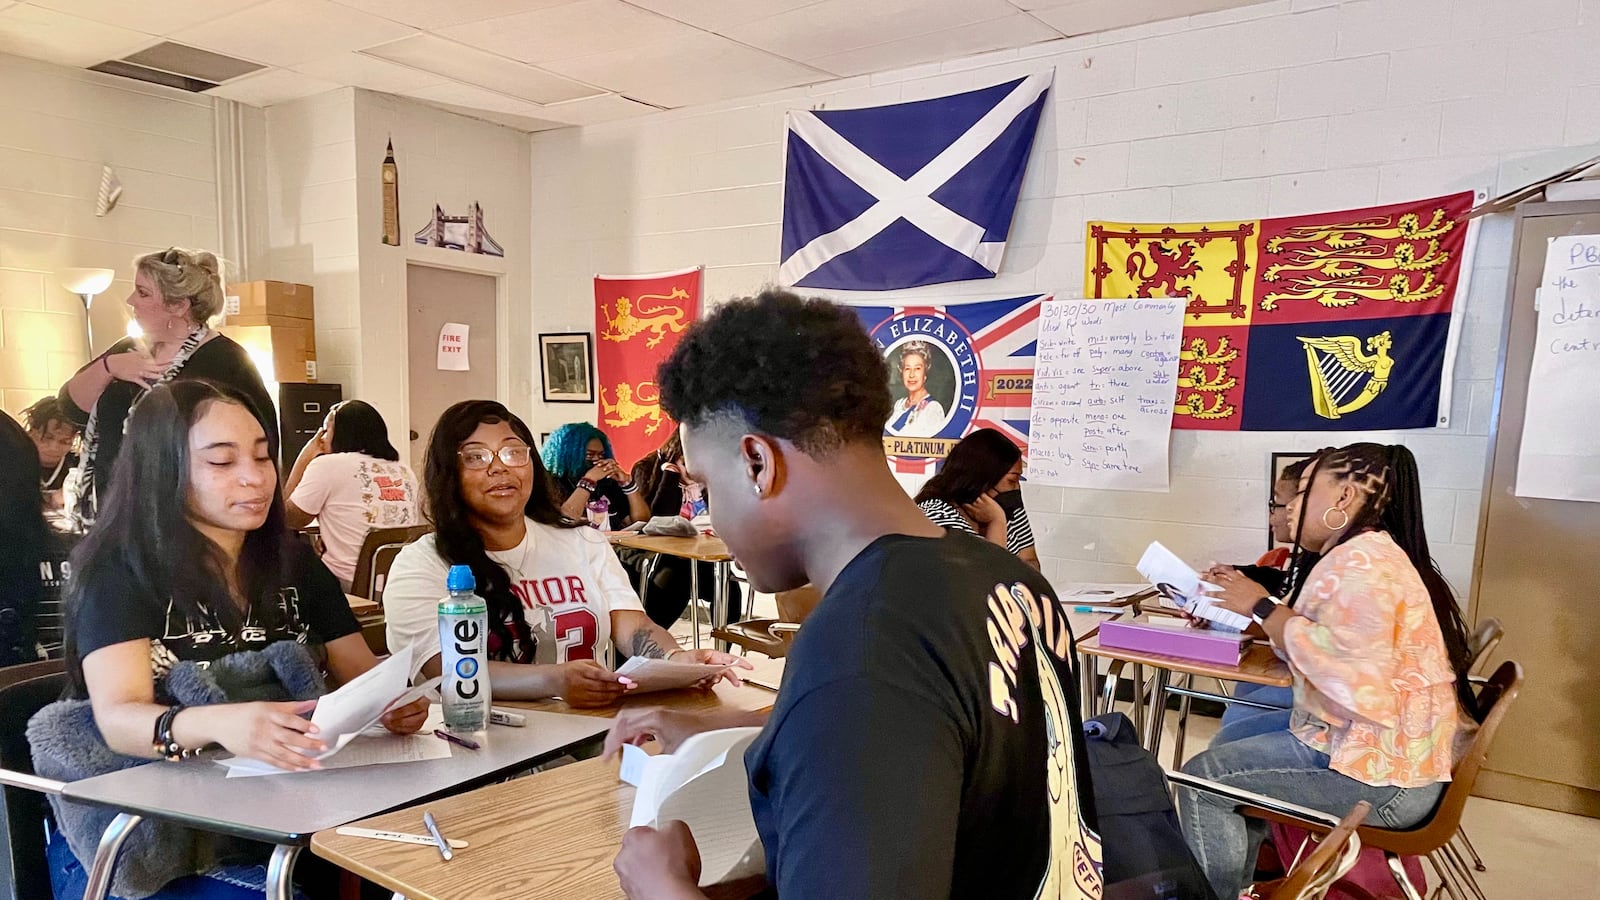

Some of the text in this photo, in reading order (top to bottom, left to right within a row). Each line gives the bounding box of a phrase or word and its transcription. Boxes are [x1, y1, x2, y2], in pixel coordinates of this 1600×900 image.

[1552, 276, 1577, 290] the
[1103, 302, 1127, 317] Most
[442, 334, 461, 342] FIRE
[890, 317, 976, 412] ELIZABETH II
[997, 378, 1032, 390] 2022
[893, 440, 945, 455] PLATINUM
[508, 575, 587, 610] NIOR
[454, 619, 479, 699] core
